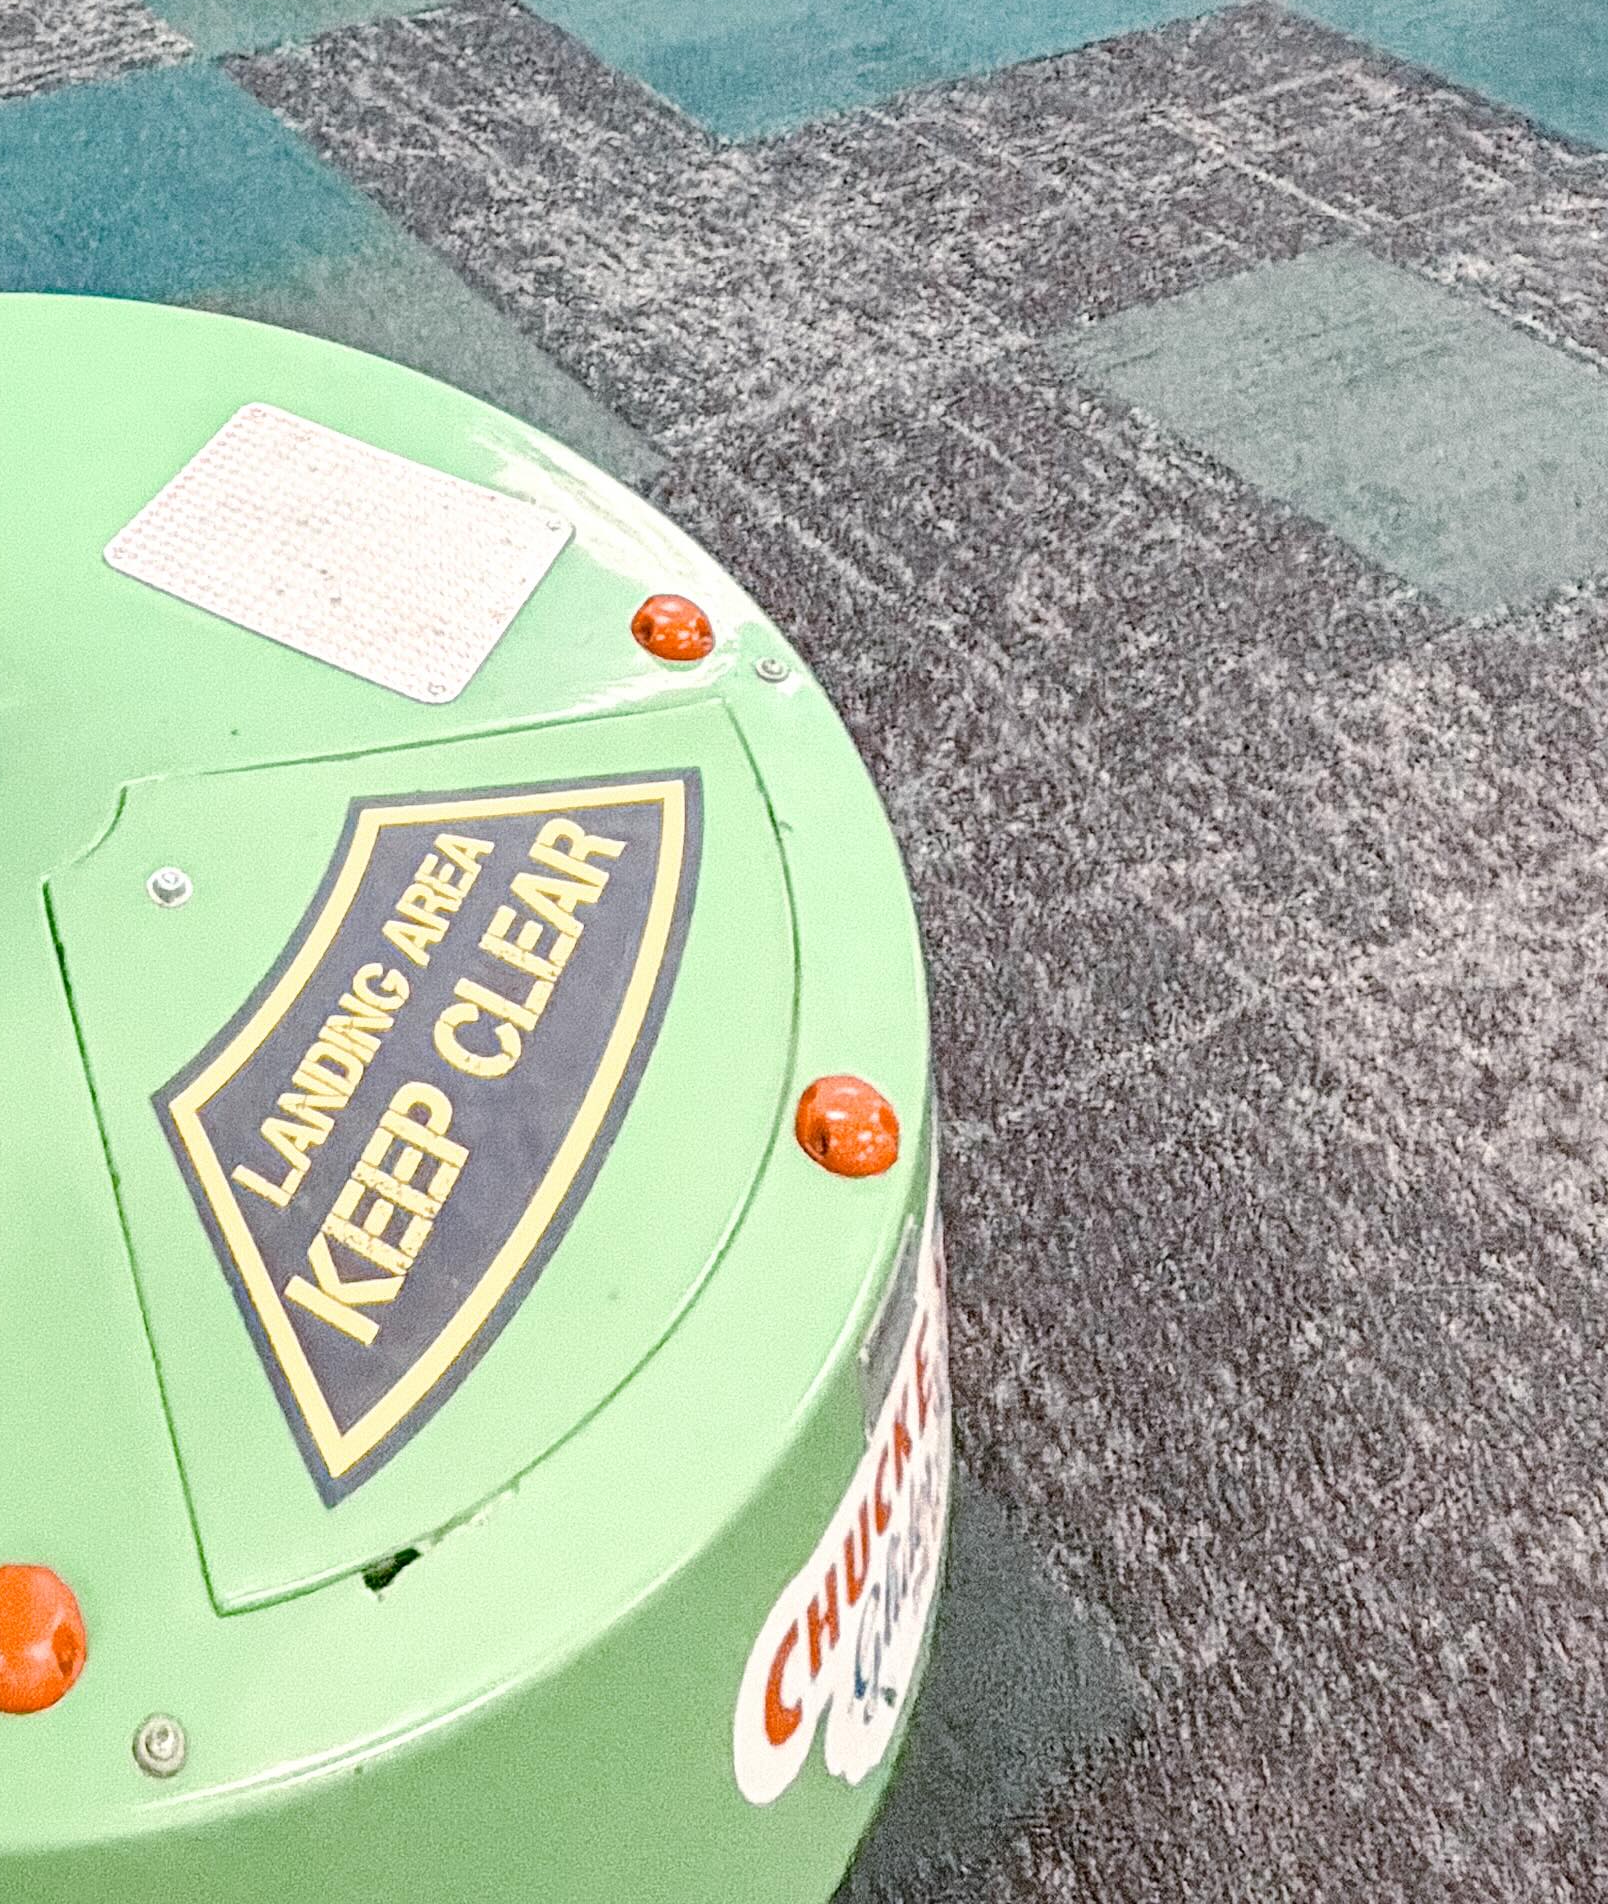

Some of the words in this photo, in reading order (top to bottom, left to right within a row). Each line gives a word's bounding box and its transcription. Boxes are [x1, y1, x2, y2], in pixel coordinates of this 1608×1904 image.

[230, 961, 411, 1209] LANDING
[381, 832, 496, 968] AREA
[283, 1080, 471, 1347] KEEP
[433, 817, 628, 1080] CLEAR
[765, 1377, 913, 1748] CHUCK
